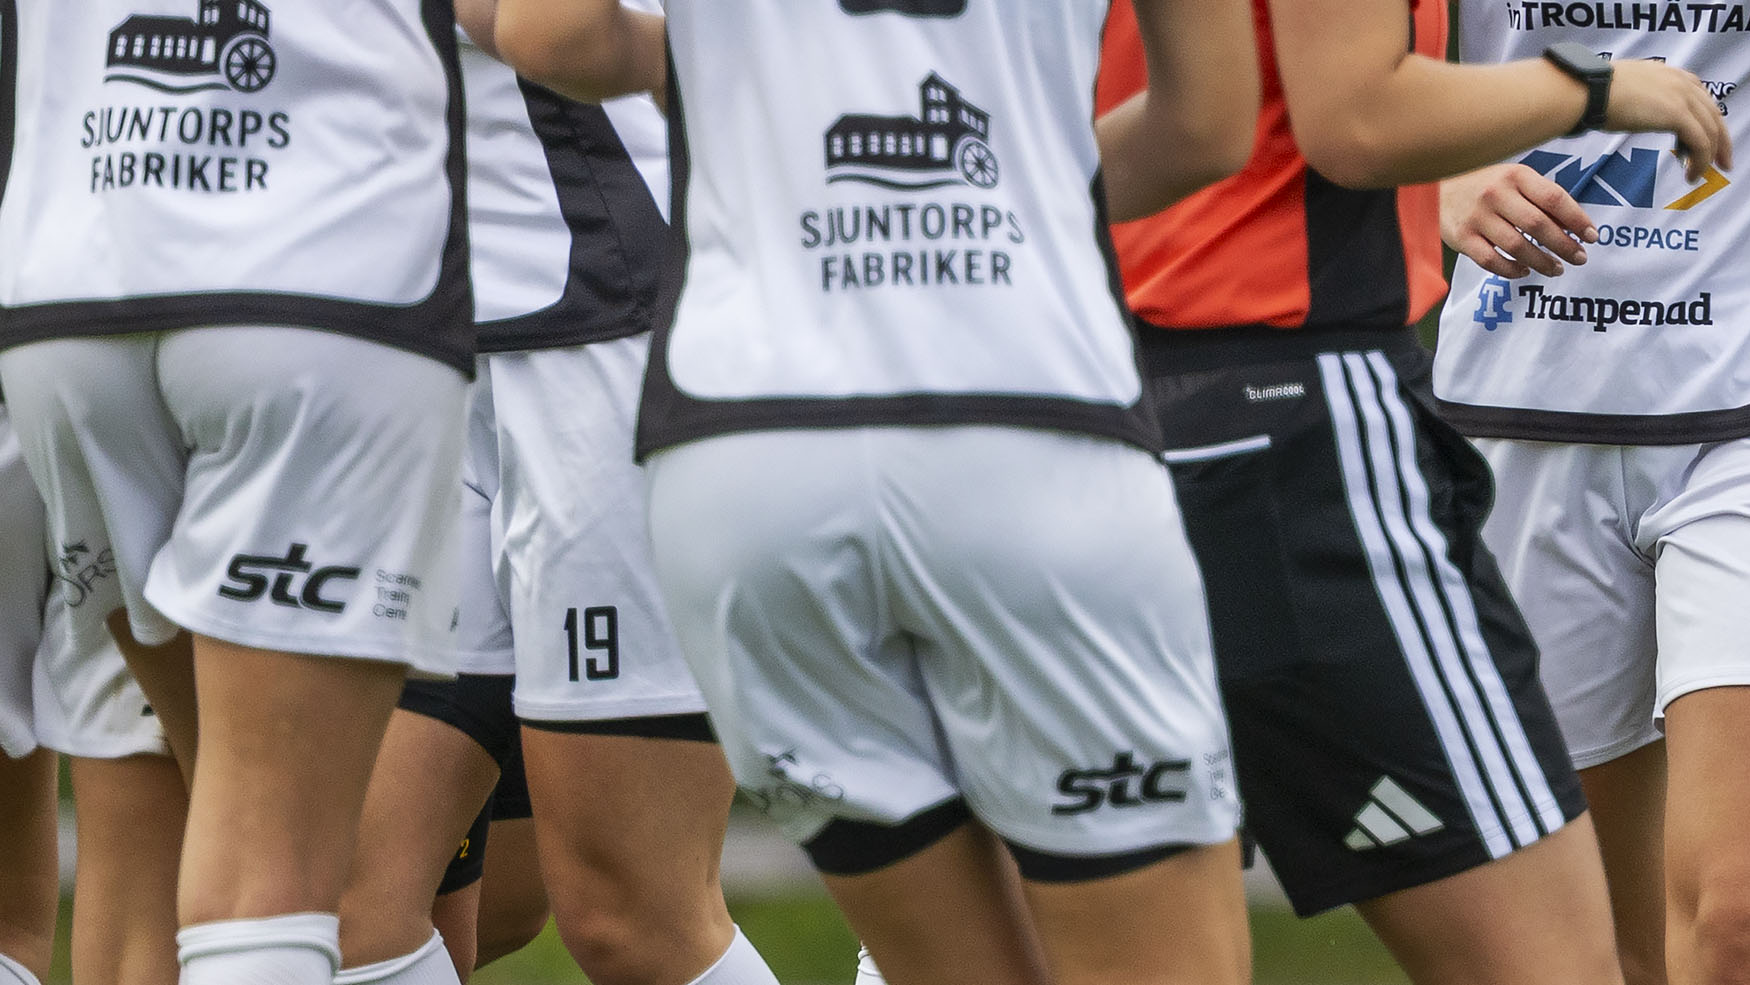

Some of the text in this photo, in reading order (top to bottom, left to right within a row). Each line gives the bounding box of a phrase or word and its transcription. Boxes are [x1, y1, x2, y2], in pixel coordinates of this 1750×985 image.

[82, 107, 291, 149] SJUNTORPS
[91, 156, 269, 194] FABRIKER
[799, 202, 1026, 249] SJUNTORPS
[821, 249, 1014, 292] FABRIKER
[1519, 285, 1713, 332] Tranpenad
[218, 542, 362, 615] stc
[562, 605, 619, 683] 19
[1050, 749, 1192, 816] stc
